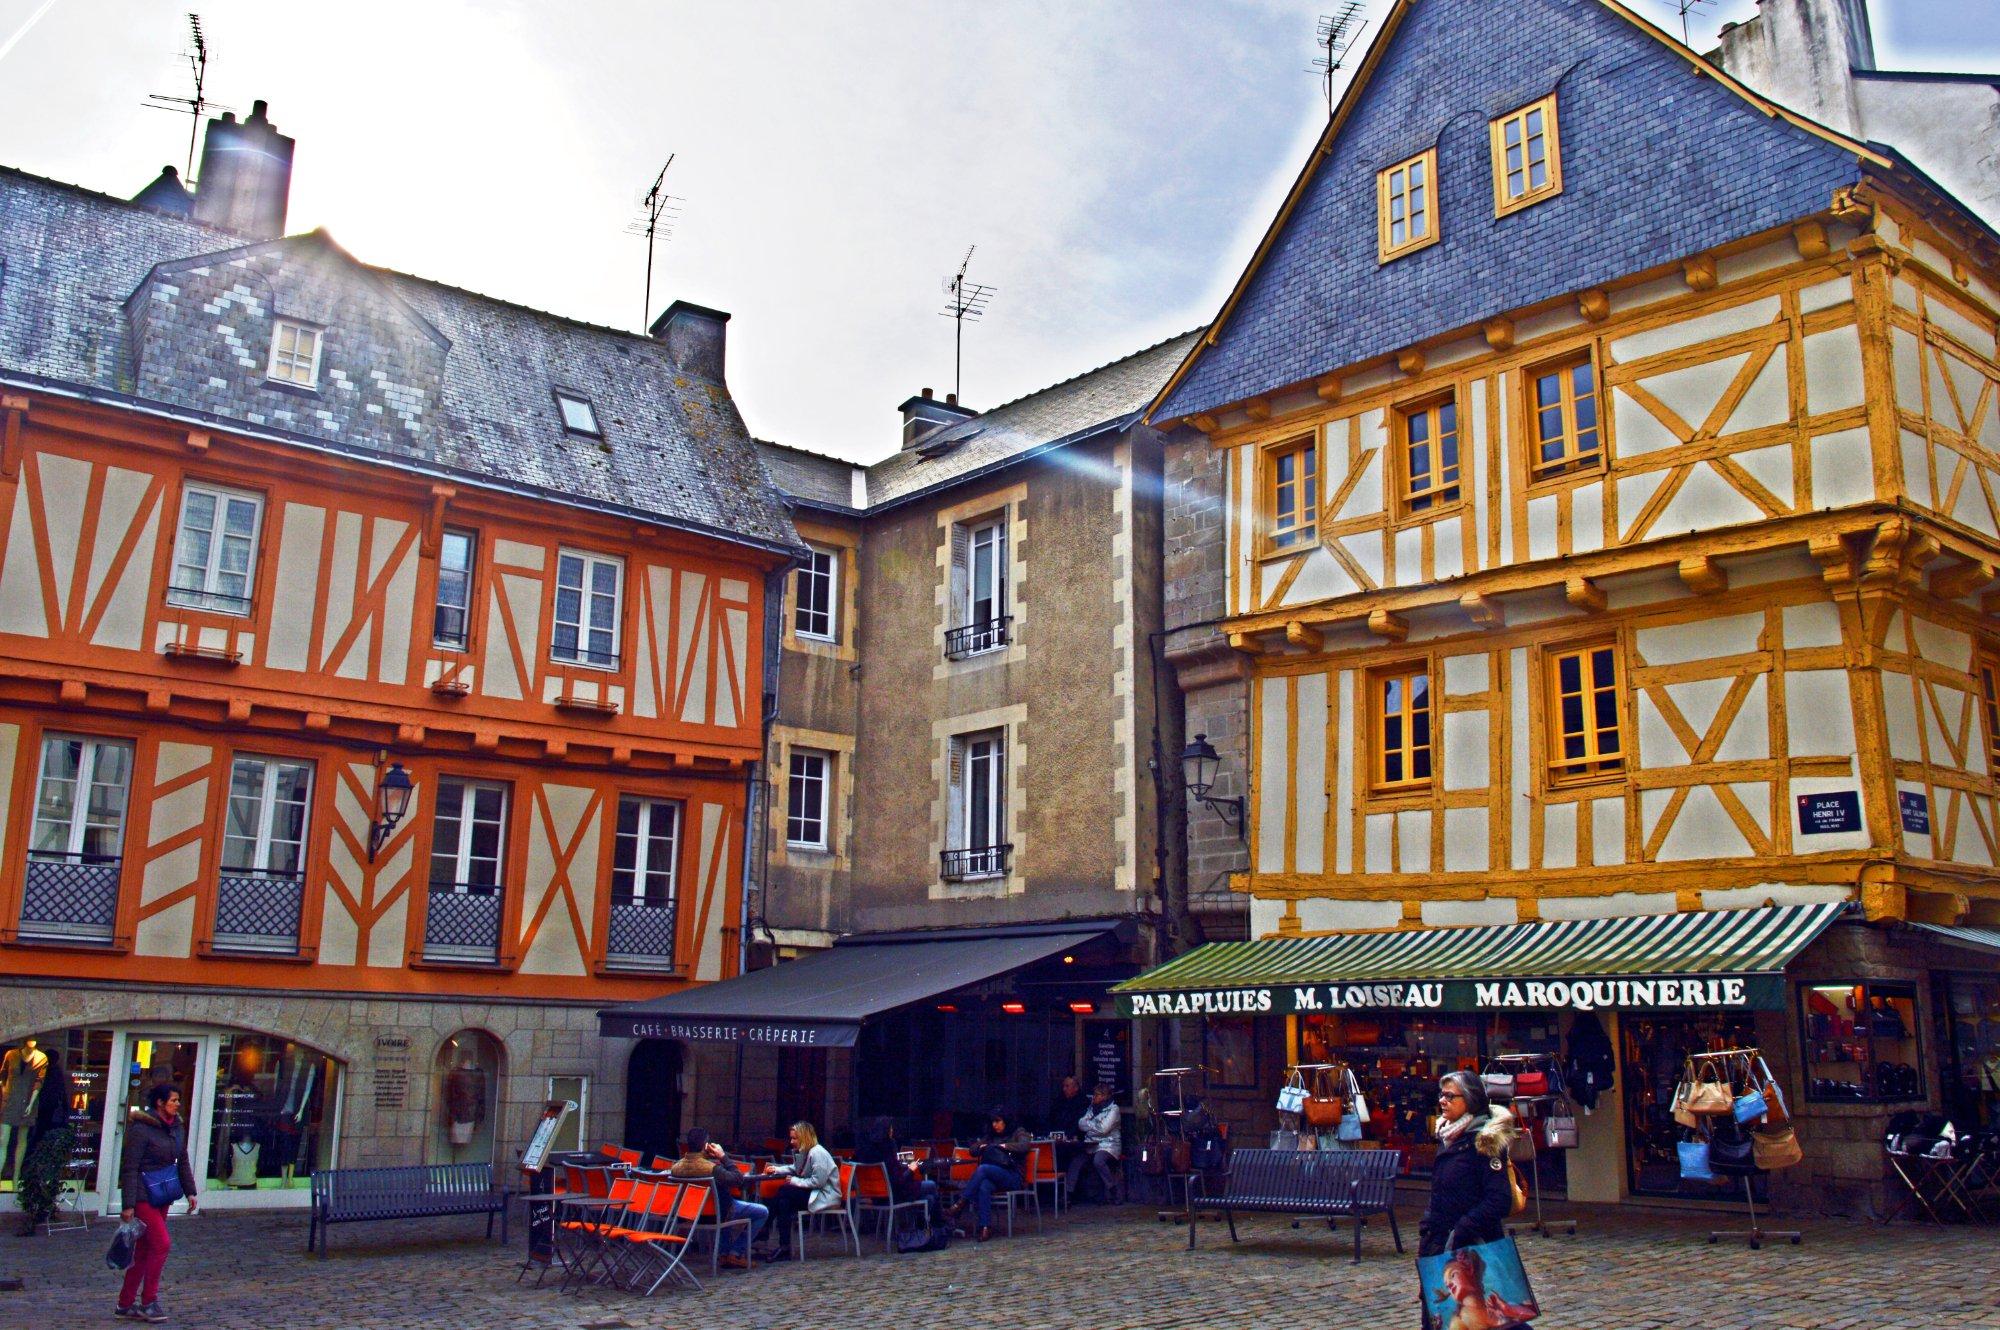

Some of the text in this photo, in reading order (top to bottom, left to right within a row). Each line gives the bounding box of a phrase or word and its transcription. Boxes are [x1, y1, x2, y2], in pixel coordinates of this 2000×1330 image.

[1816, 800, 1840, 809] PLACE
[1812, 809, 1845, 818] HENRI IV
[1131, 978, 1747, 1015] PARAPLUIES M. LOISEAU MAROQUINERIE
[632, 1022, 816, 1044] CAFÉ BRASSERIE CRÊPERIE
[377, 1038, 410, 1048] IVOIRE
